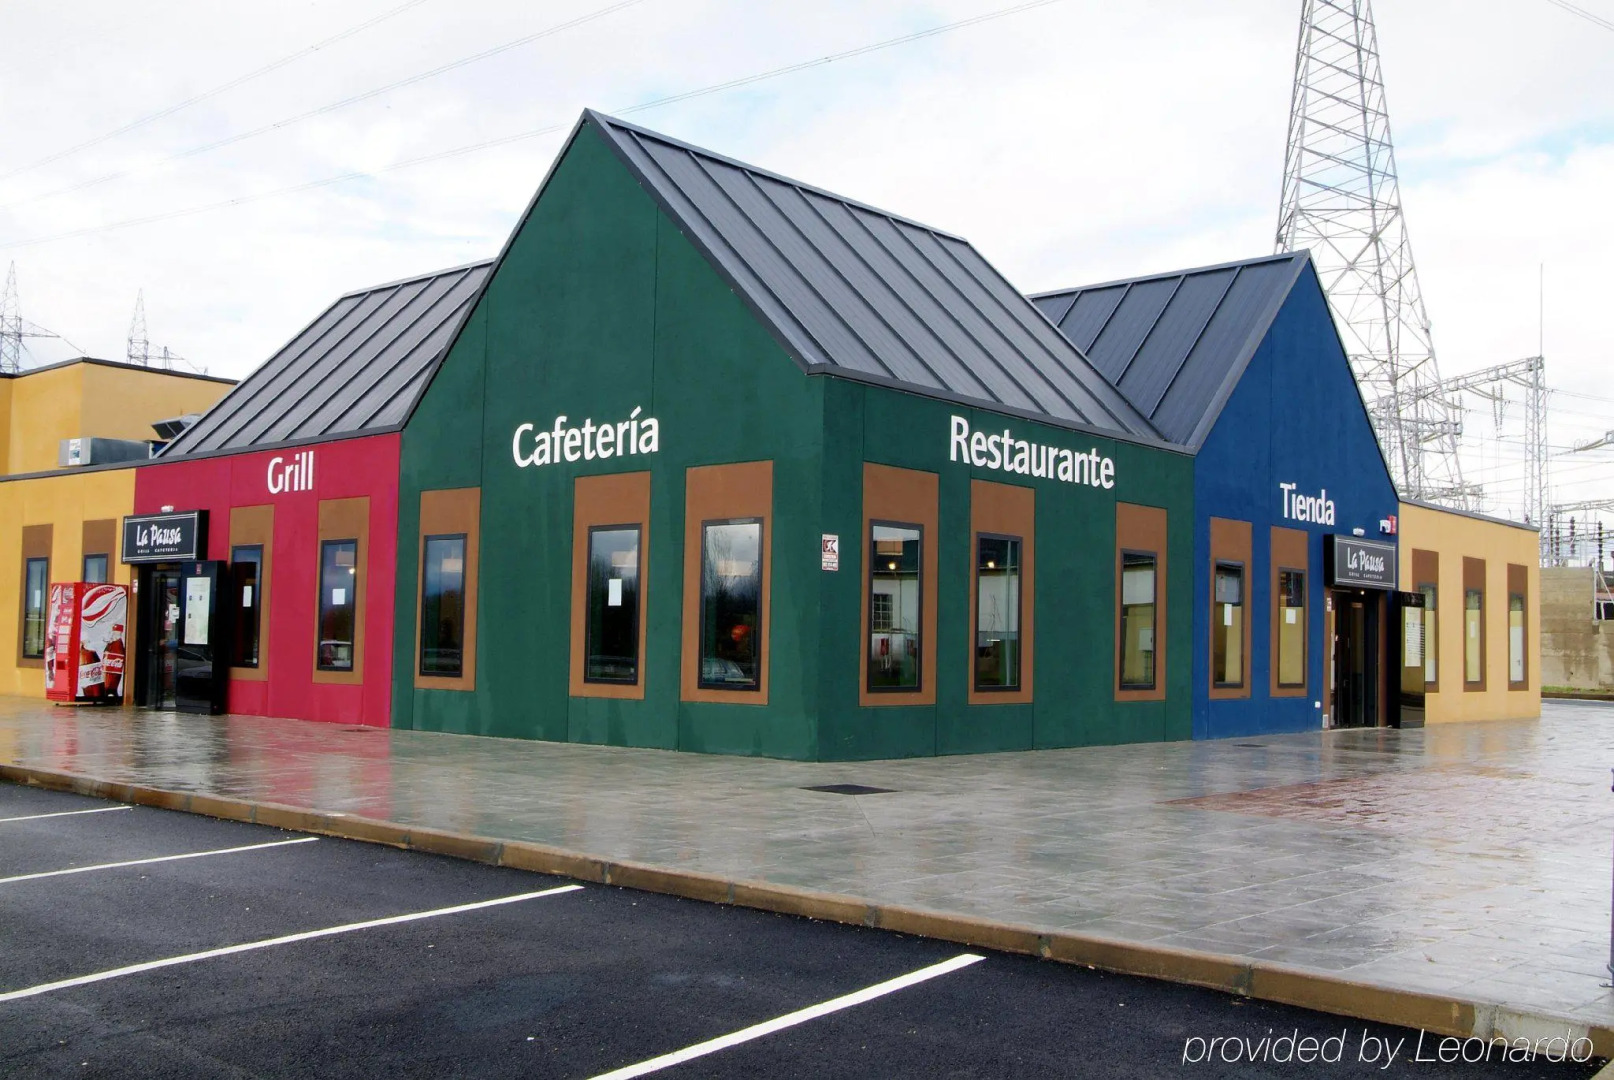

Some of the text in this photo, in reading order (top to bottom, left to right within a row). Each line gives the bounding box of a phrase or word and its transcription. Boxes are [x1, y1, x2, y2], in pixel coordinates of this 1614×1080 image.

[512, 406, 660, 469] Cafetería
[949, 414, 1116, 490] Restaurante
[267, 451, 314, 495] Grill
[1279, 482, 1335, 526] Tienda
[136, 523, 182, 547] La Pausa
[1347, 547, 1385, 572] La Pausa
